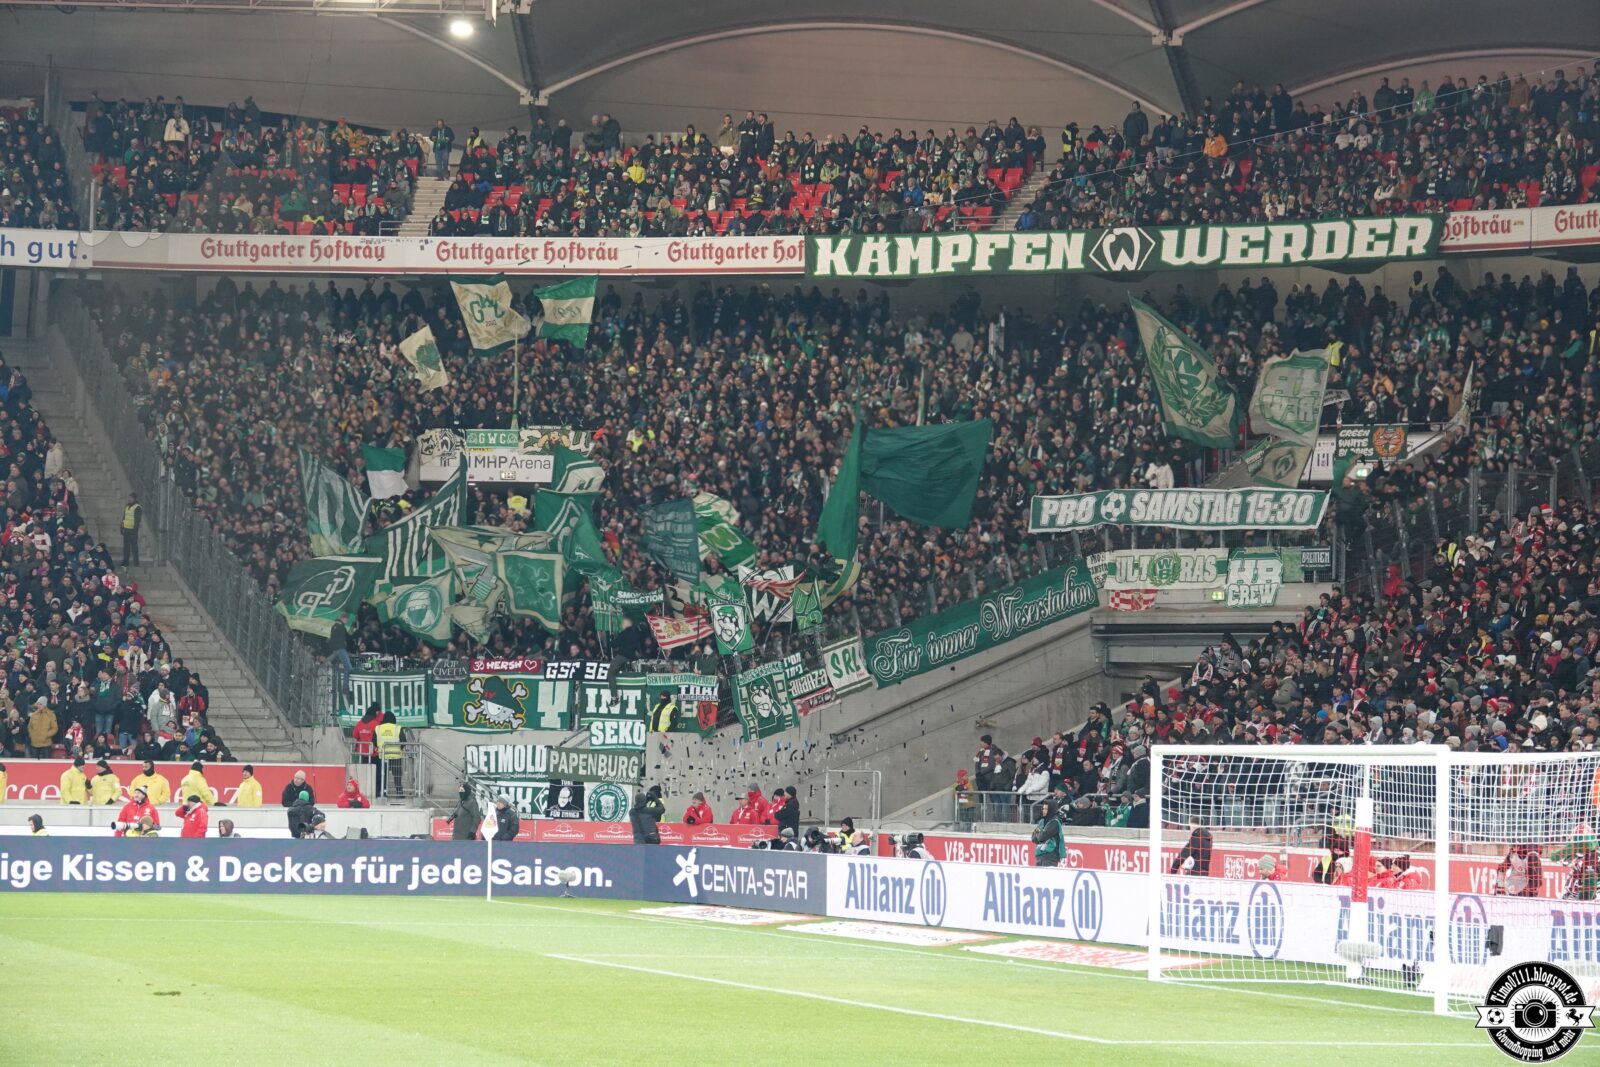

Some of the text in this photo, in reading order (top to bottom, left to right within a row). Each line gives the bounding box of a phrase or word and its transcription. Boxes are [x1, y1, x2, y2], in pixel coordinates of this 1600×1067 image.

[27, 239, 89, 263] gut.
[200, 237, 386, 263] Stuttgarter Hofbräu
[435, 239, 619, 264] Stuttgarter Hofbräu
[667, 240, 768, 264] Stuttgarter
[813, 232, 1085, 277] KÄMPFEN
[1160, 217, 1434, 266] WERDER
[1040, 491, 1315, 526] PRO SAMSTAG 15:30
[1226, 583, 1279, 607] CREW
[871, 627, 923, 682] Für
[926, 624, 980, 665] immer
[980, 566, 1096, 642] Weserstadion
[486, 660, 523, 670] HERSH
[591, 721, 646, 746] SEKO
[466, 745, 547, 774] DETMOLD
[549, 750, 639, 778] PAPENBURG
[944, 841, 1029, 867] VfB-STIFTUNG
[61, 853, 177, 883] Kissen
[185, 855, 210, 883] &
[218, 856, 344, 884] Decken
[351, 856, 403, 884] für
[407, 857, 482, 891] jede
[491, 859, 613, 888] Saison.
[701, 863, 808, 900] CENTA-STAR
[845, 862, 915, 914] Allianz
[983, 871, 1066, 928] Allianz
